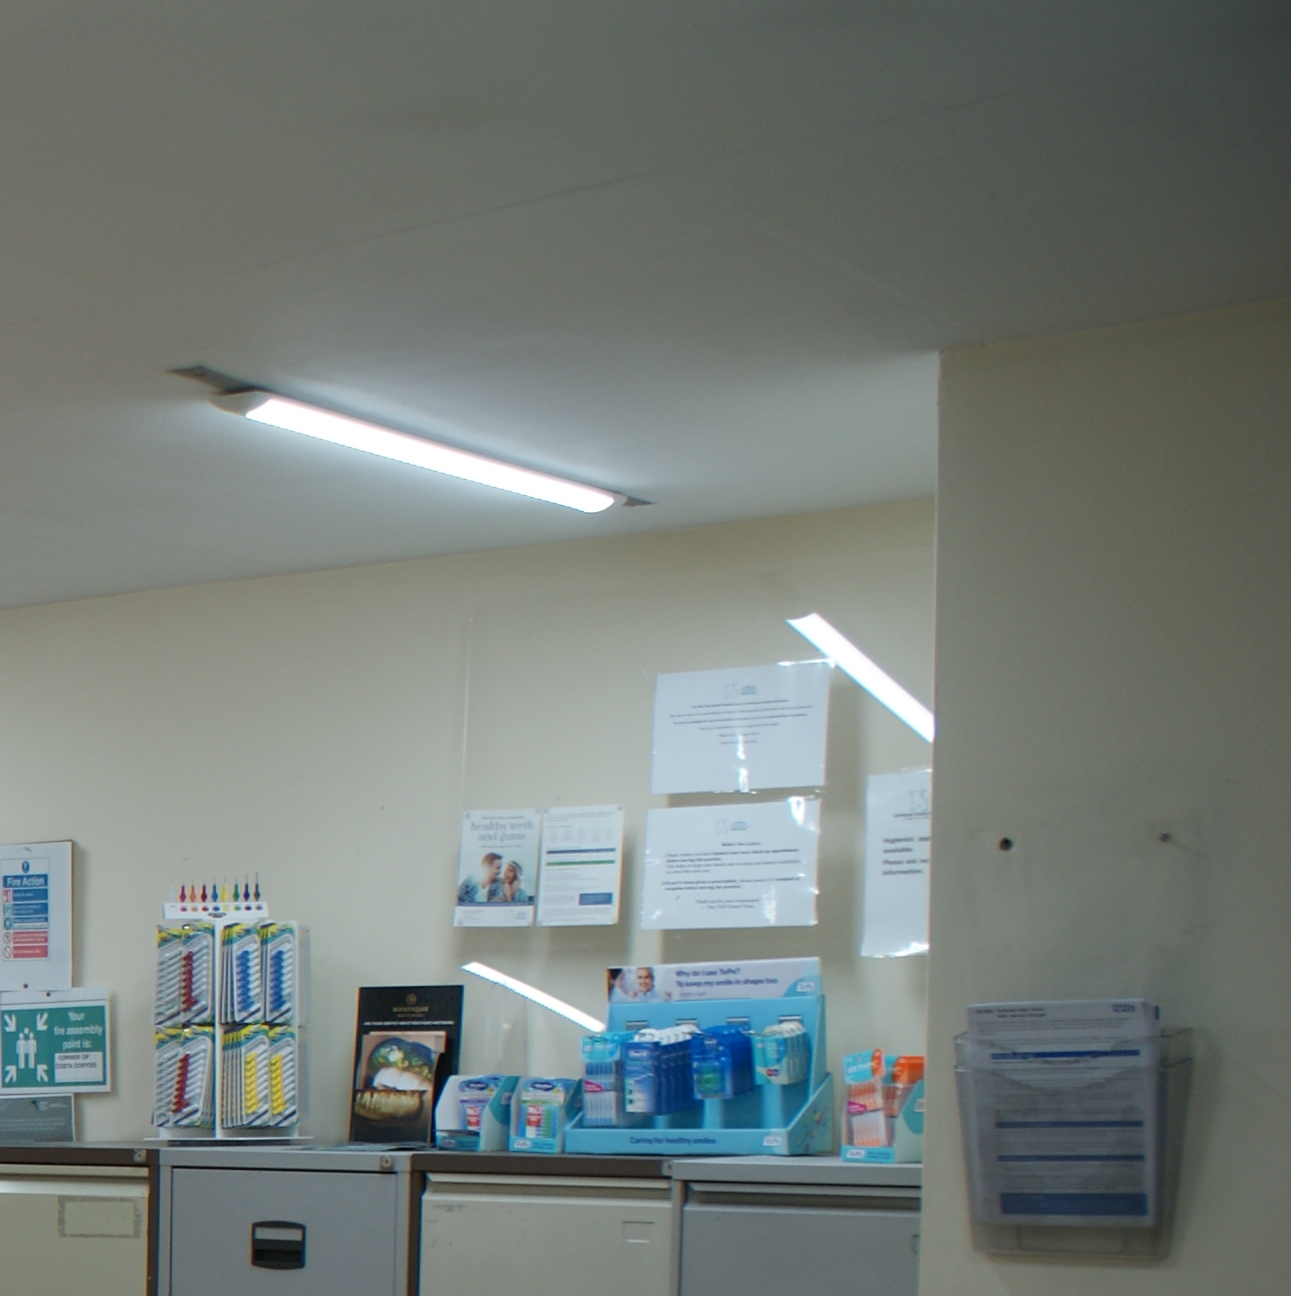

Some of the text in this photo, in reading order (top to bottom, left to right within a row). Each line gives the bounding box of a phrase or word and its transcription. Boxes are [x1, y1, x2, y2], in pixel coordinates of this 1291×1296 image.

[471, 821, 535, 831] healthy teeth
[478, 833, 497, 841] and
[6, 877, 44, 886] Fire Action
[675, 970, 691, 978] Why
[686, 980, 702, 988] keep
[744, 978, 764, 987] shape
[68, 1011, 85, 1021] Your
[54, 1024, 103, 1036] fire assembly
[62, 1039, 93, 1051] point is:
[629, 1137, 652, 1145] Caring
[665, 1137, 691, 1145] healthy
